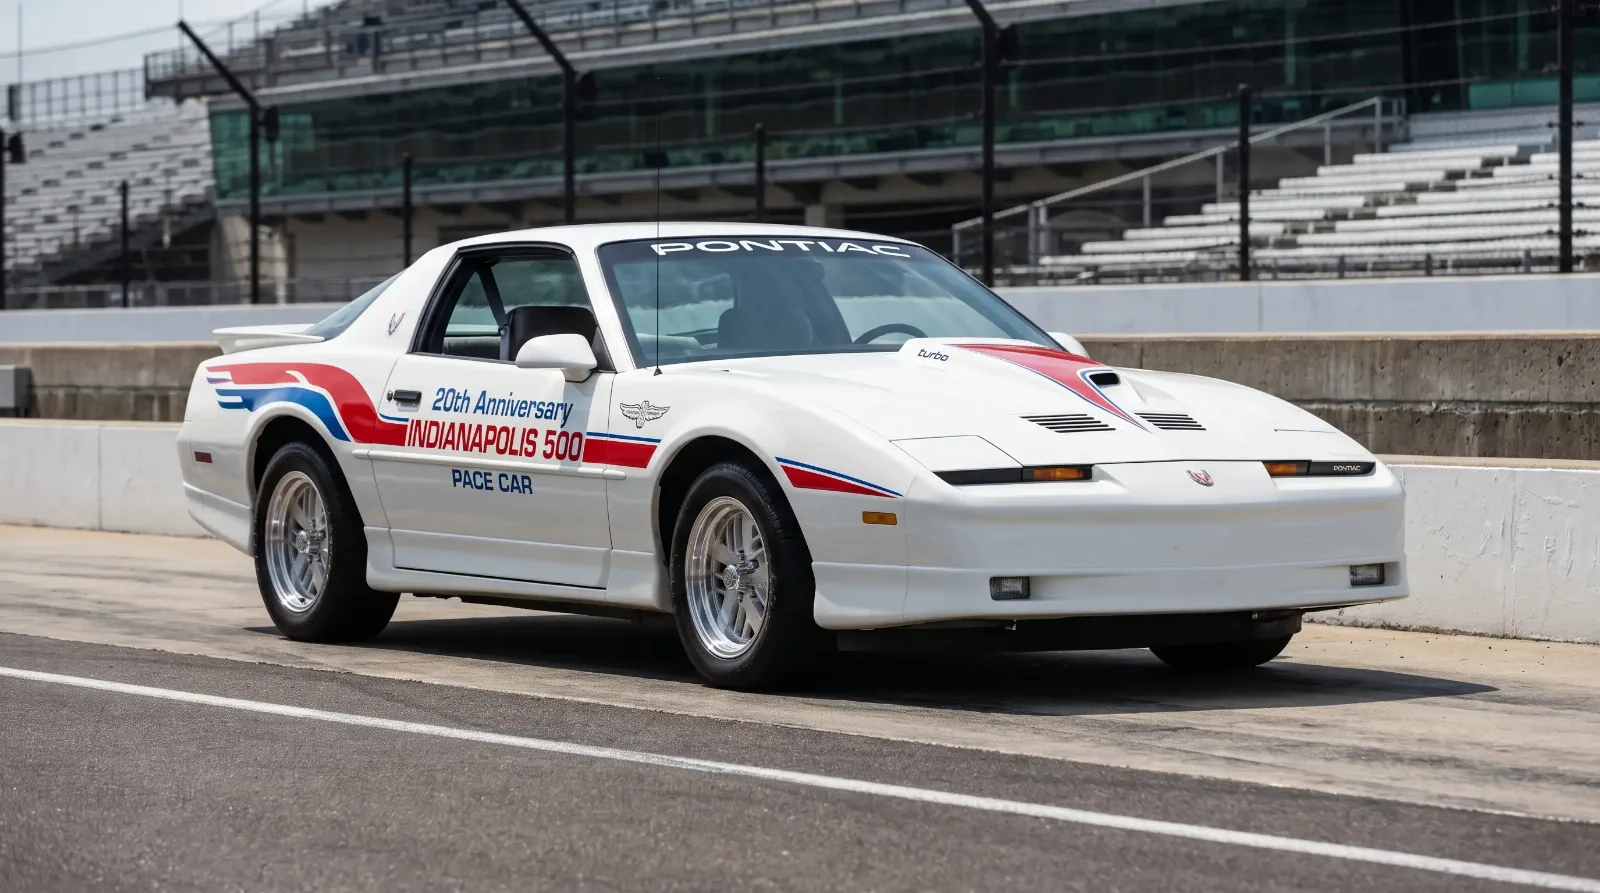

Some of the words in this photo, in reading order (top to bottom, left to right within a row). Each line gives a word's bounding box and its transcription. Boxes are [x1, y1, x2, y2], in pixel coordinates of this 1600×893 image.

[651, 239, 911, 258] PONTIAC
[917, 348, 949, 361] turbo
[432, 387, 471, 413] 20th
[473, 390, 573, 428] Anniversary
[408, 419, 538, 457] INDIANAPOLIS
[542, 430, 583, 462] 500
[452, 469, 494, 491] PACE
[499, 473, 533, 495] CAR
